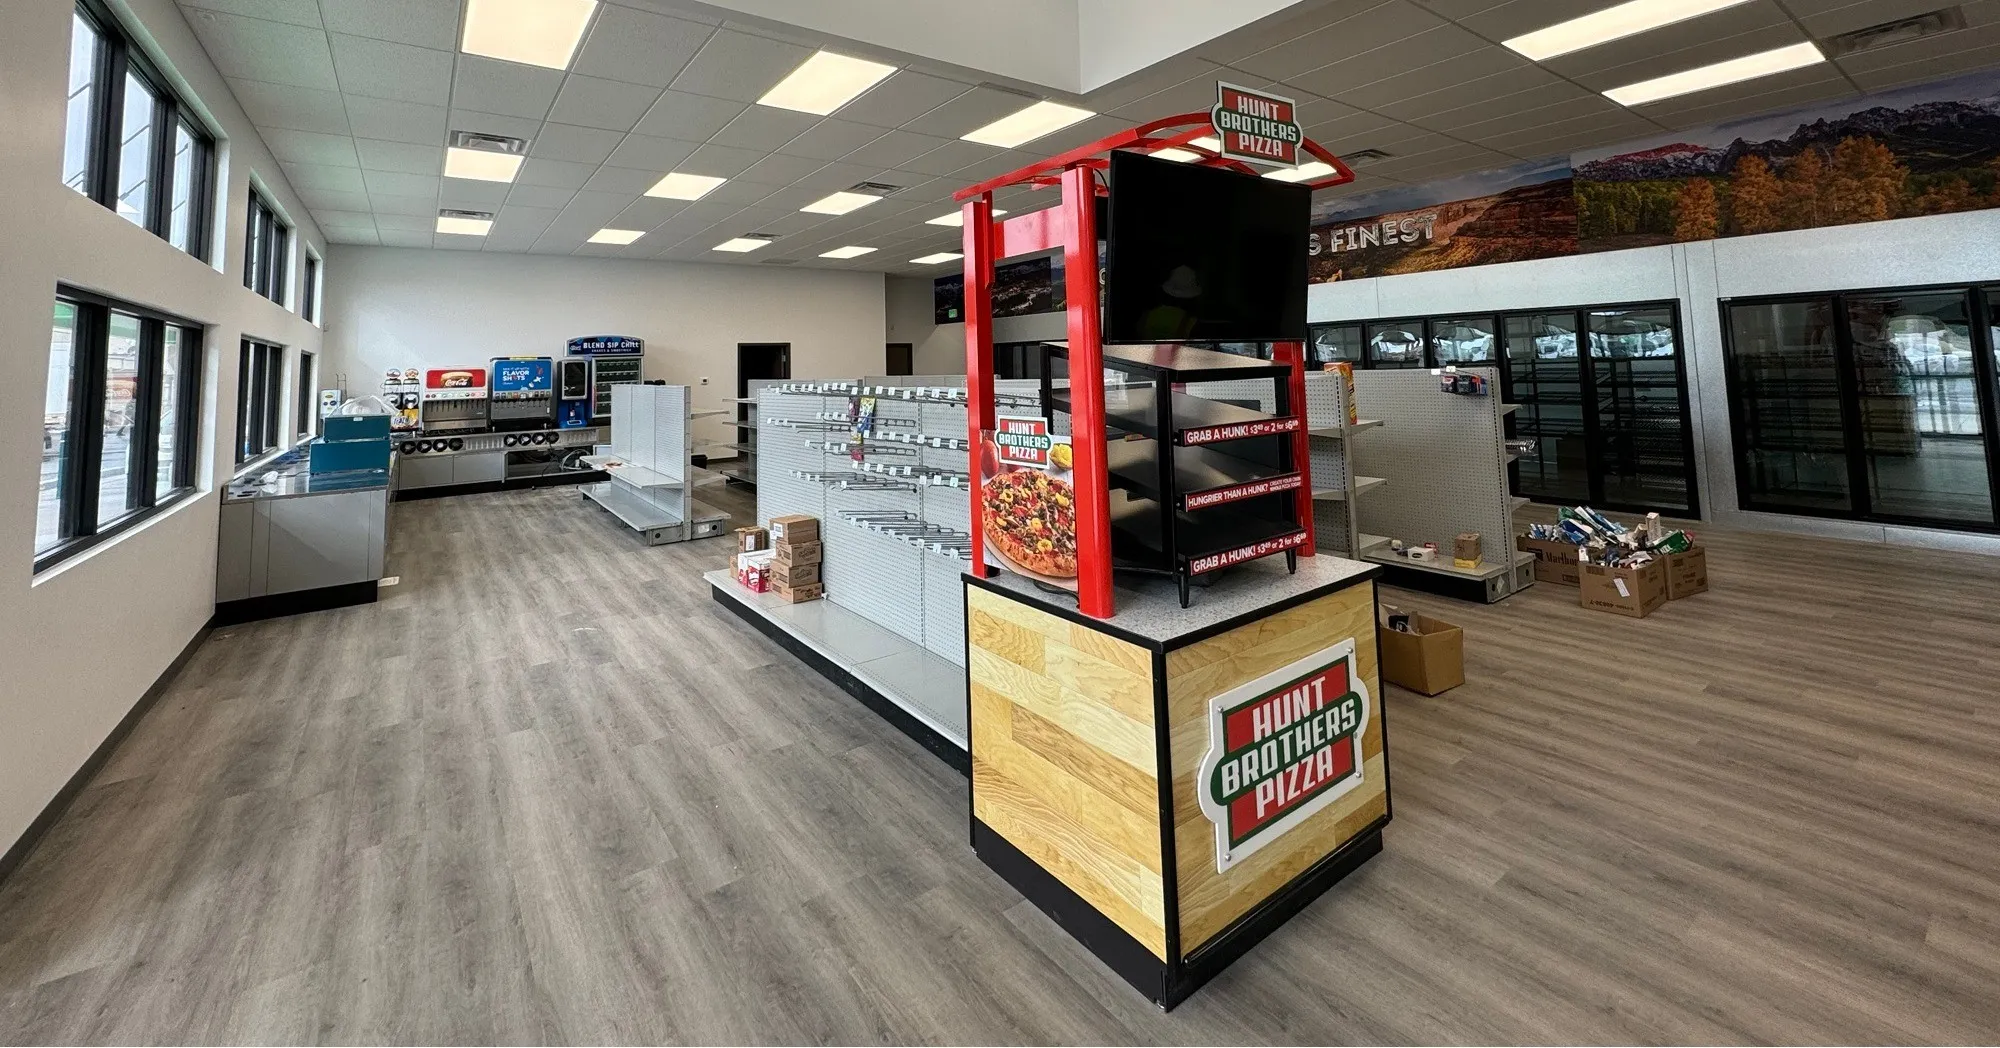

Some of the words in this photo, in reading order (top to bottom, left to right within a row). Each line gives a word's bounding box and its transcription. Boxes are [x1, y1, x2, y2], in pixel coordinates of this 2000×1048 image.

[1238, 96, 1278, 120] HUNT
[1220, 110, 1296, 142] BROTHERS
[1238, 132, 1282, 156] PIZZA
[1330, 214, 1438, 252] FINEST
[1009, 422, 1036, 435] HUNT
[1187, 430, 1212, 443] GRAB
[1213, 429, 1220, 440] A
[1221, 425, 1249, 438] HUNK!
[1271, 423, 1276, 432] 2
[999, 434, 1048, 448] BROTHERS
[1009, 446, 1038, 460] PIZZA
[1188, 493, 1223, 507] HUNGRIER
[1223, 489, 1241, 500] THAN
[1242, 487, 1247, 496] A
[1248, 483, 1268, 494] HUNK?
[1193, 556, 1218, 572] GRAB
[1220, 554, 1227, 566] A
[1228, 546, 1256, 563] HUNK!
[1278, 538, 1284, 548] 2
[1252, 676, 1326, 743] HUNT
[1221, 698, 1355, 798] BROTHERS
[1256, 744, 1333, 820] PIZZA
